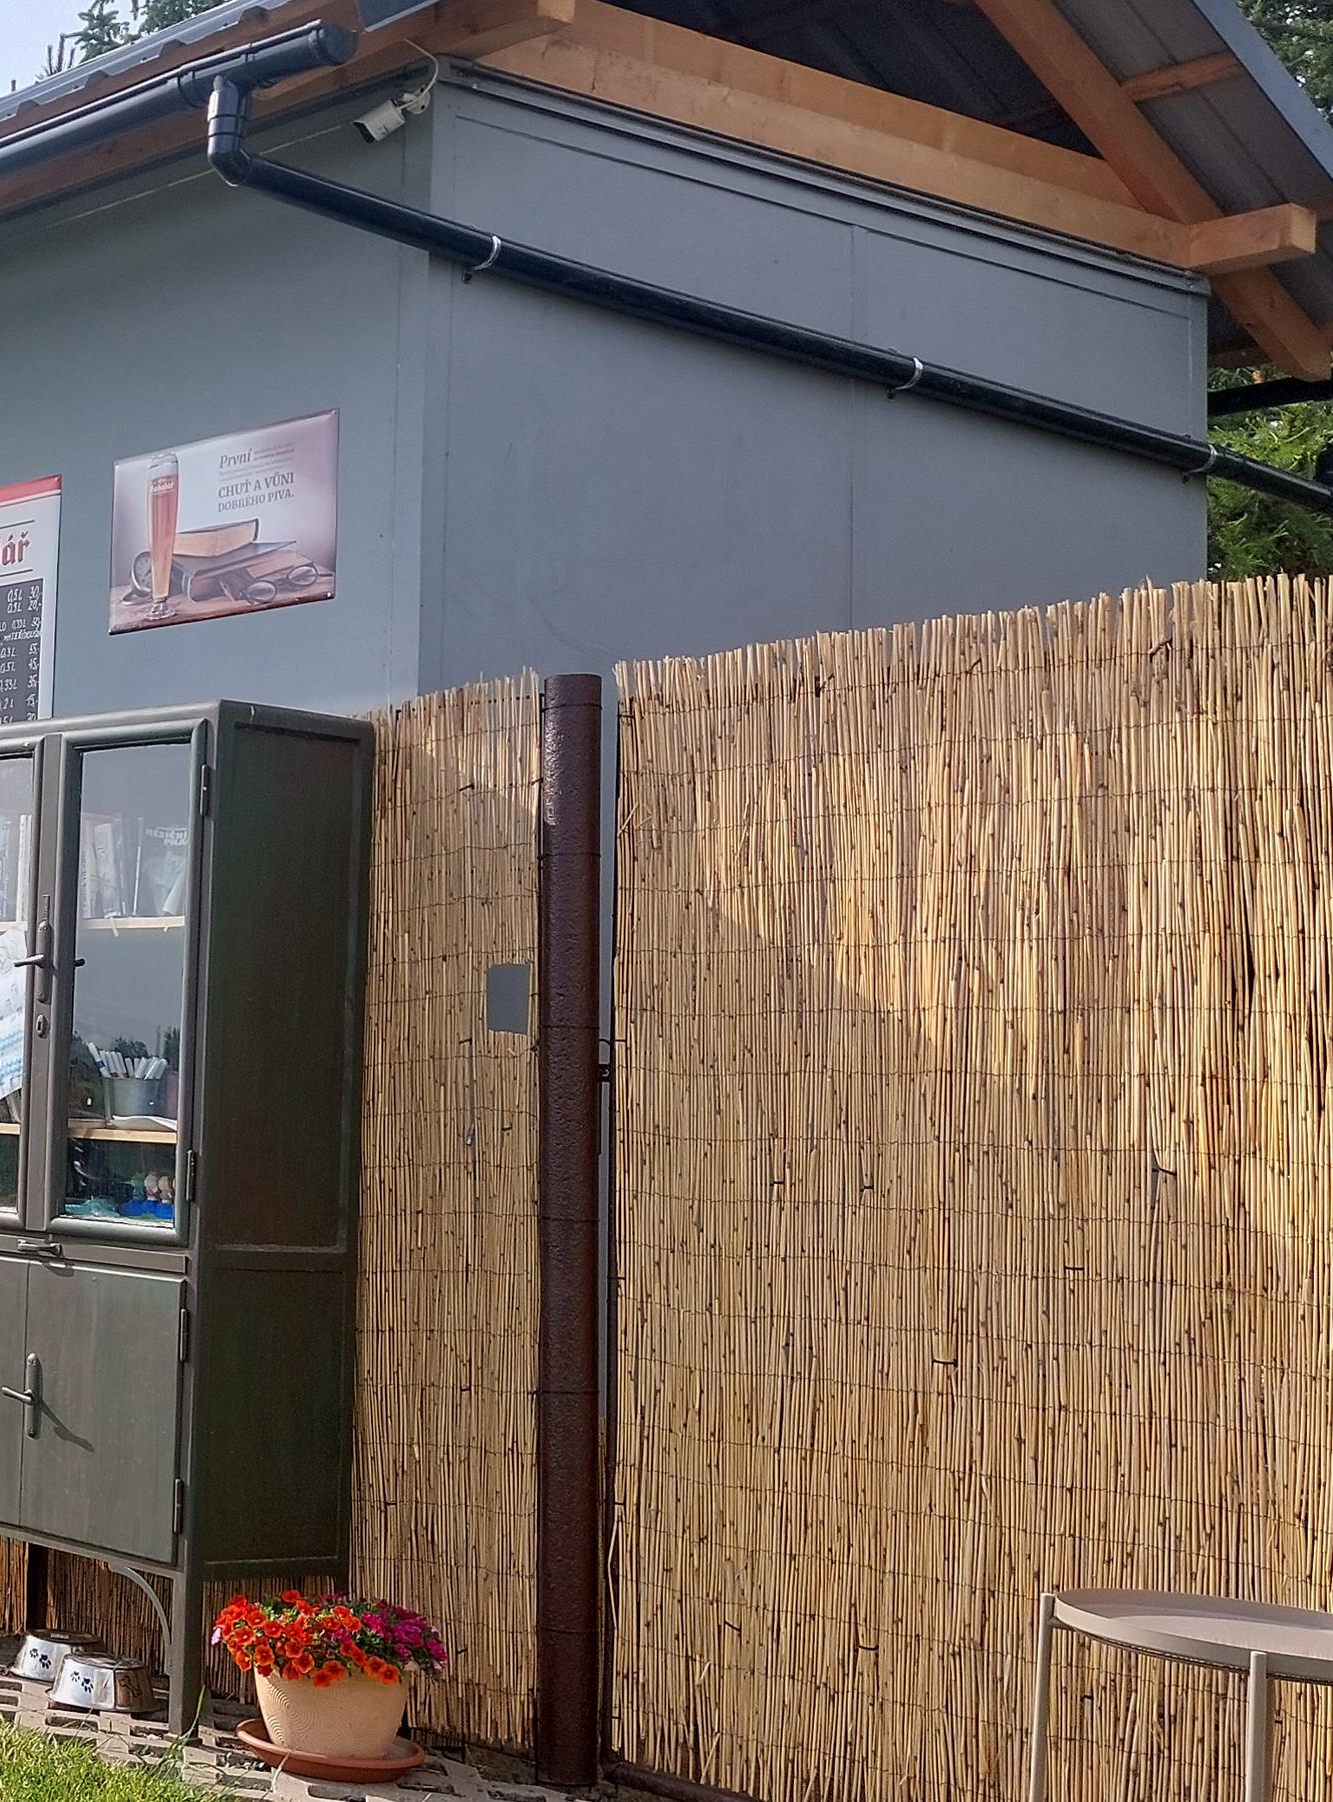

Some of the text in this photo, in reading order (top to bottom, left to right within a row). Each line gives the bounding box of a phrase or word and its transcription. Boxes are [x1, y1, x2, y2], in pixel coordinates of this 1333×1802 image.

[219, 447, 252, 469] První
[218, 479, 251, 498] CHUŤ
[254, 479, 262, 491] A
[264, 471, 294, 488] VŮNI
[218, 494, 266, 512] DOBRÉHO
